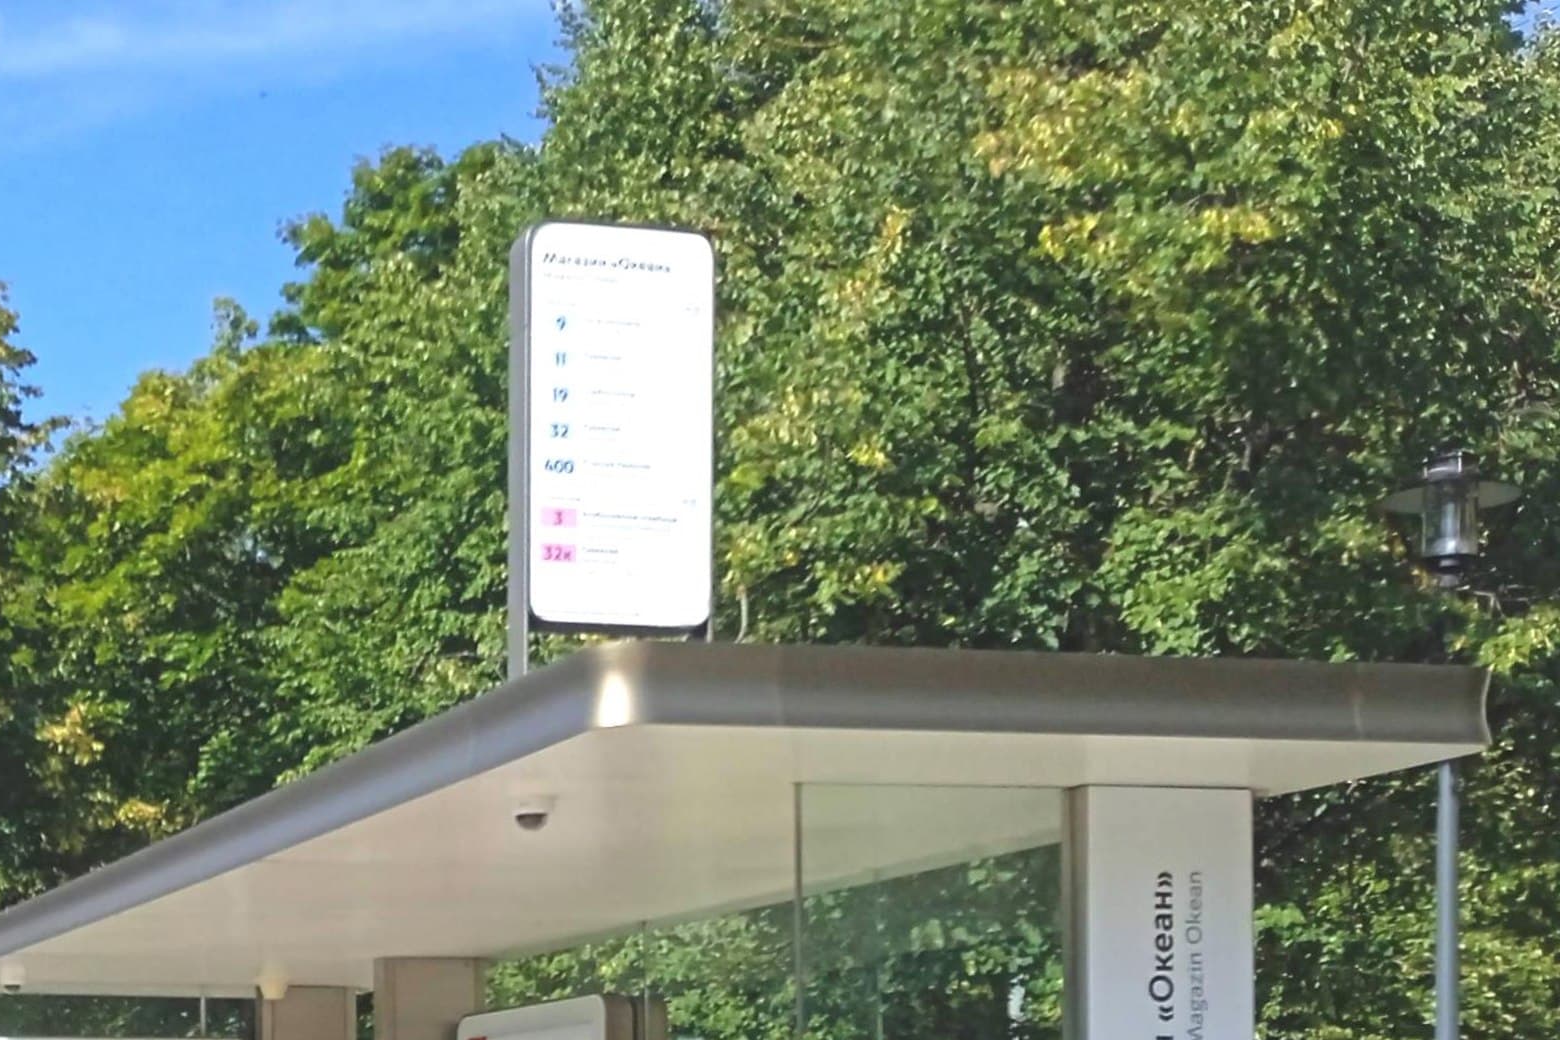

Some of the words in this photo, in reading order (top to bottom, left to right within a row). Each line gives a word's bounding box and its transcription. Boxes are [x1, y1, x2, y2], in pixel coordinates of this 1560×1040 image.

[556, 316, 566, 331] 9
[555, 352, 567, 366] 11
[553, 388, 568, 402] 19
[551, 424, 569, 438] 32
[544, 459, 575, 474] 400
[553, 510, 564, 526] 3
[1185, 871, 1204, 944] Okean
[1148, 871, 1175, 1023] «Океан»
